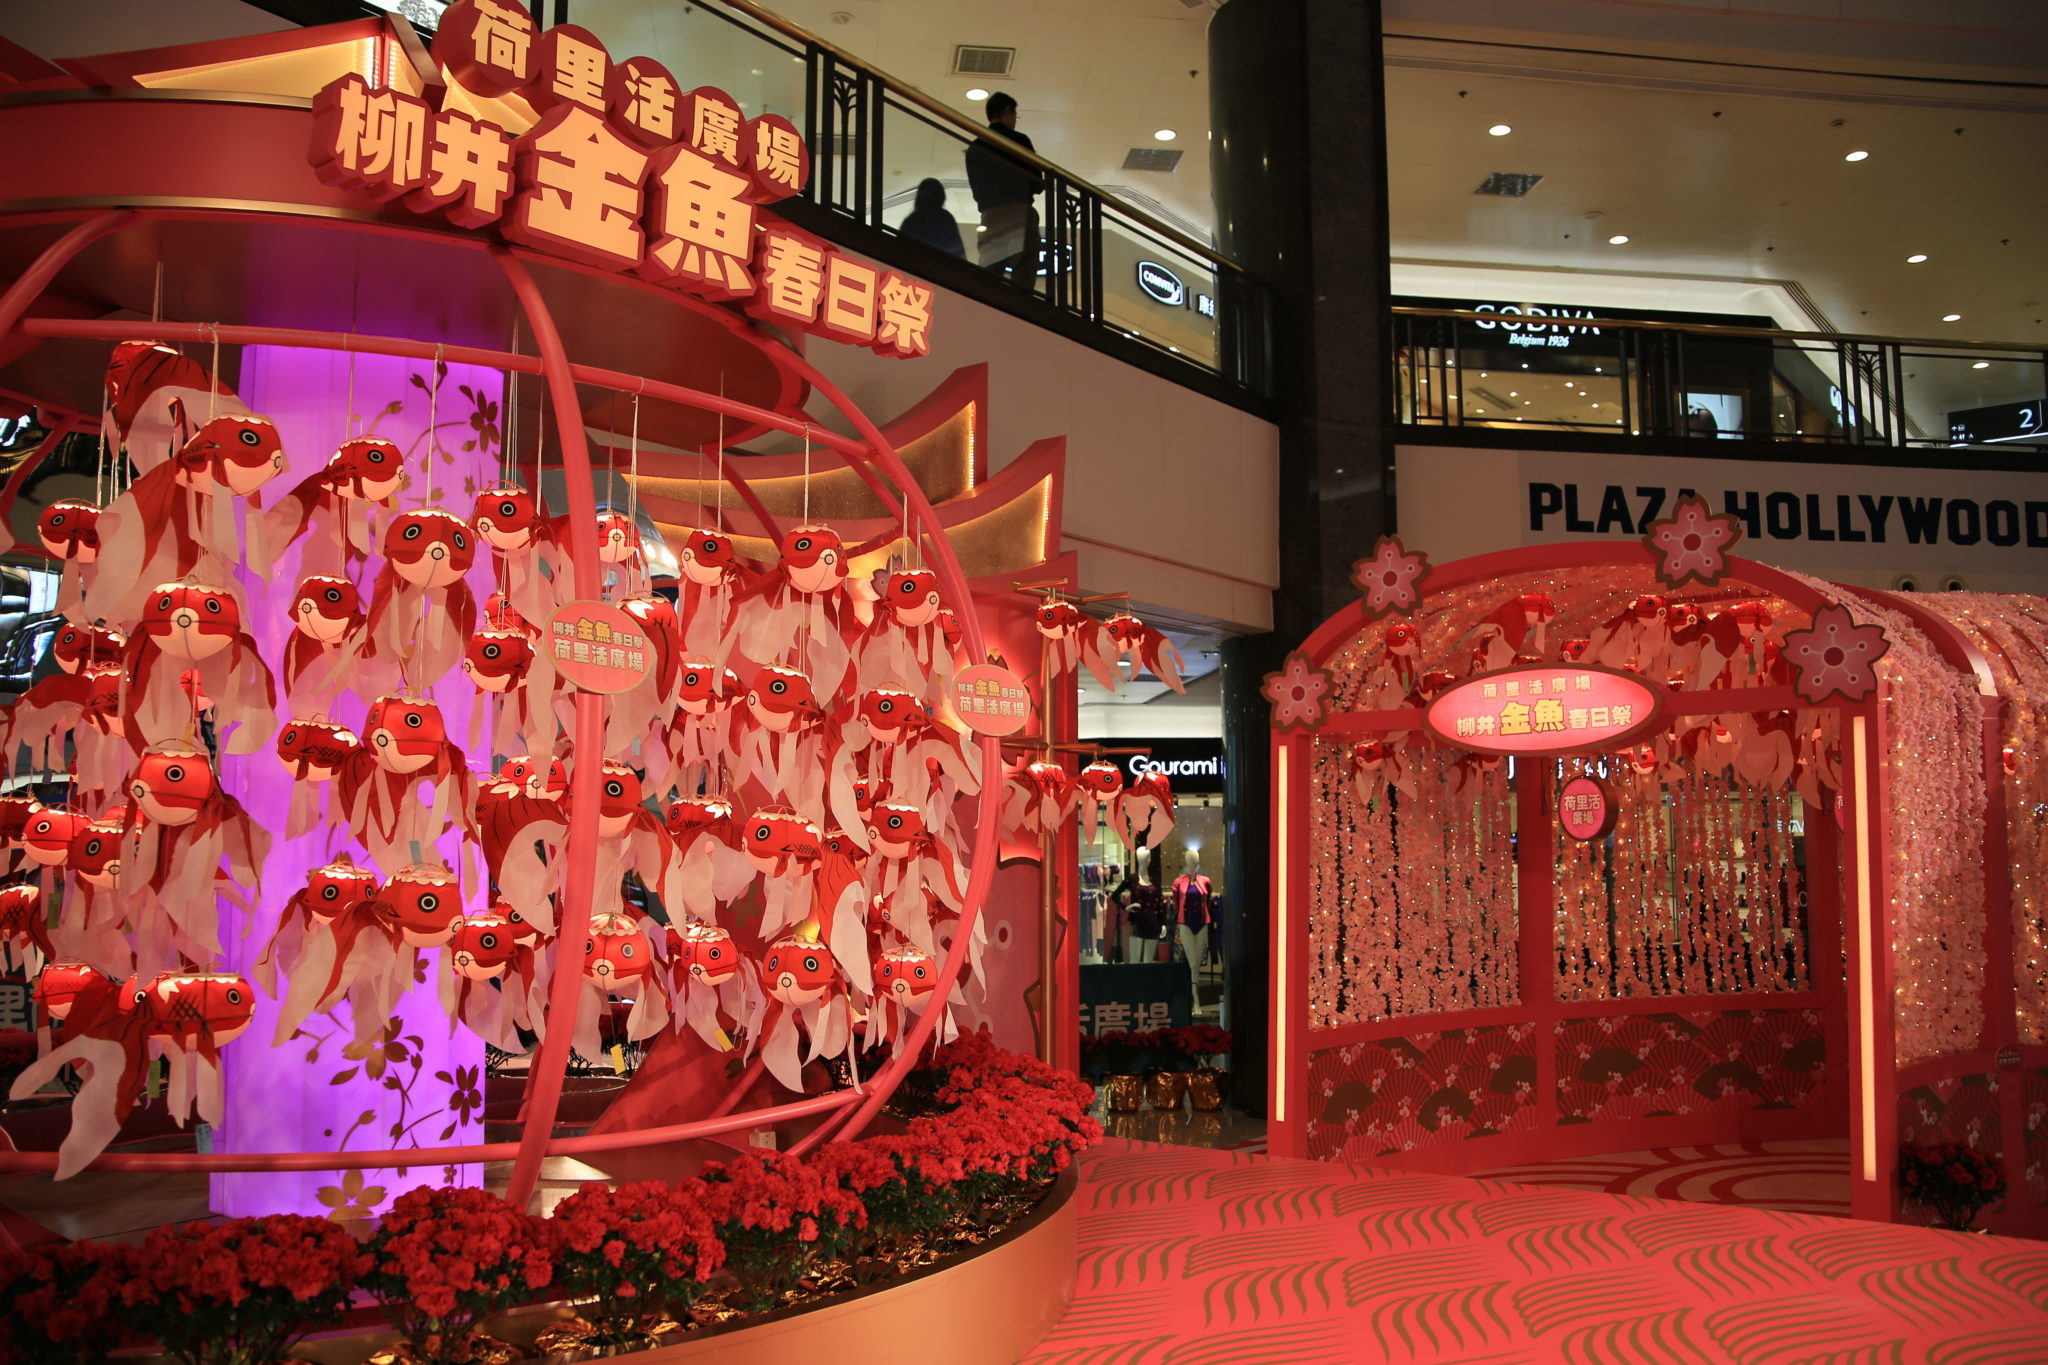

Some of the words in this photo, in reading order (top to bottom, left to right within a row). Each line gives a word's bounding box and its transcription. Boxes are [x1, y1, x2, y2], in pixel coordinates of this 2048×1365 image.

[471, 0, 801, 190] 荷里活廣場
[334, 80, 935, 352] 柳井金魚春日祭
[1475, 304, 1600, 335] GODIVA
[1508, 333, 1546, 348] Belgium
[1547, 335, 1570, 347] 1926
[2018, 408, 2034, 428] 2
[1529, 483, 1698, 534] PLAZ
[554, 638, 644, 673] 荷里活廣場
[1482, 675, 1592, 699] 荷里活廣場
[1456, 698, 1633, 738] 柳井金魚春日祭
[1129, 755, 1217, 775] Gourami
[1564, 794, 1600, 811] 荷里活
